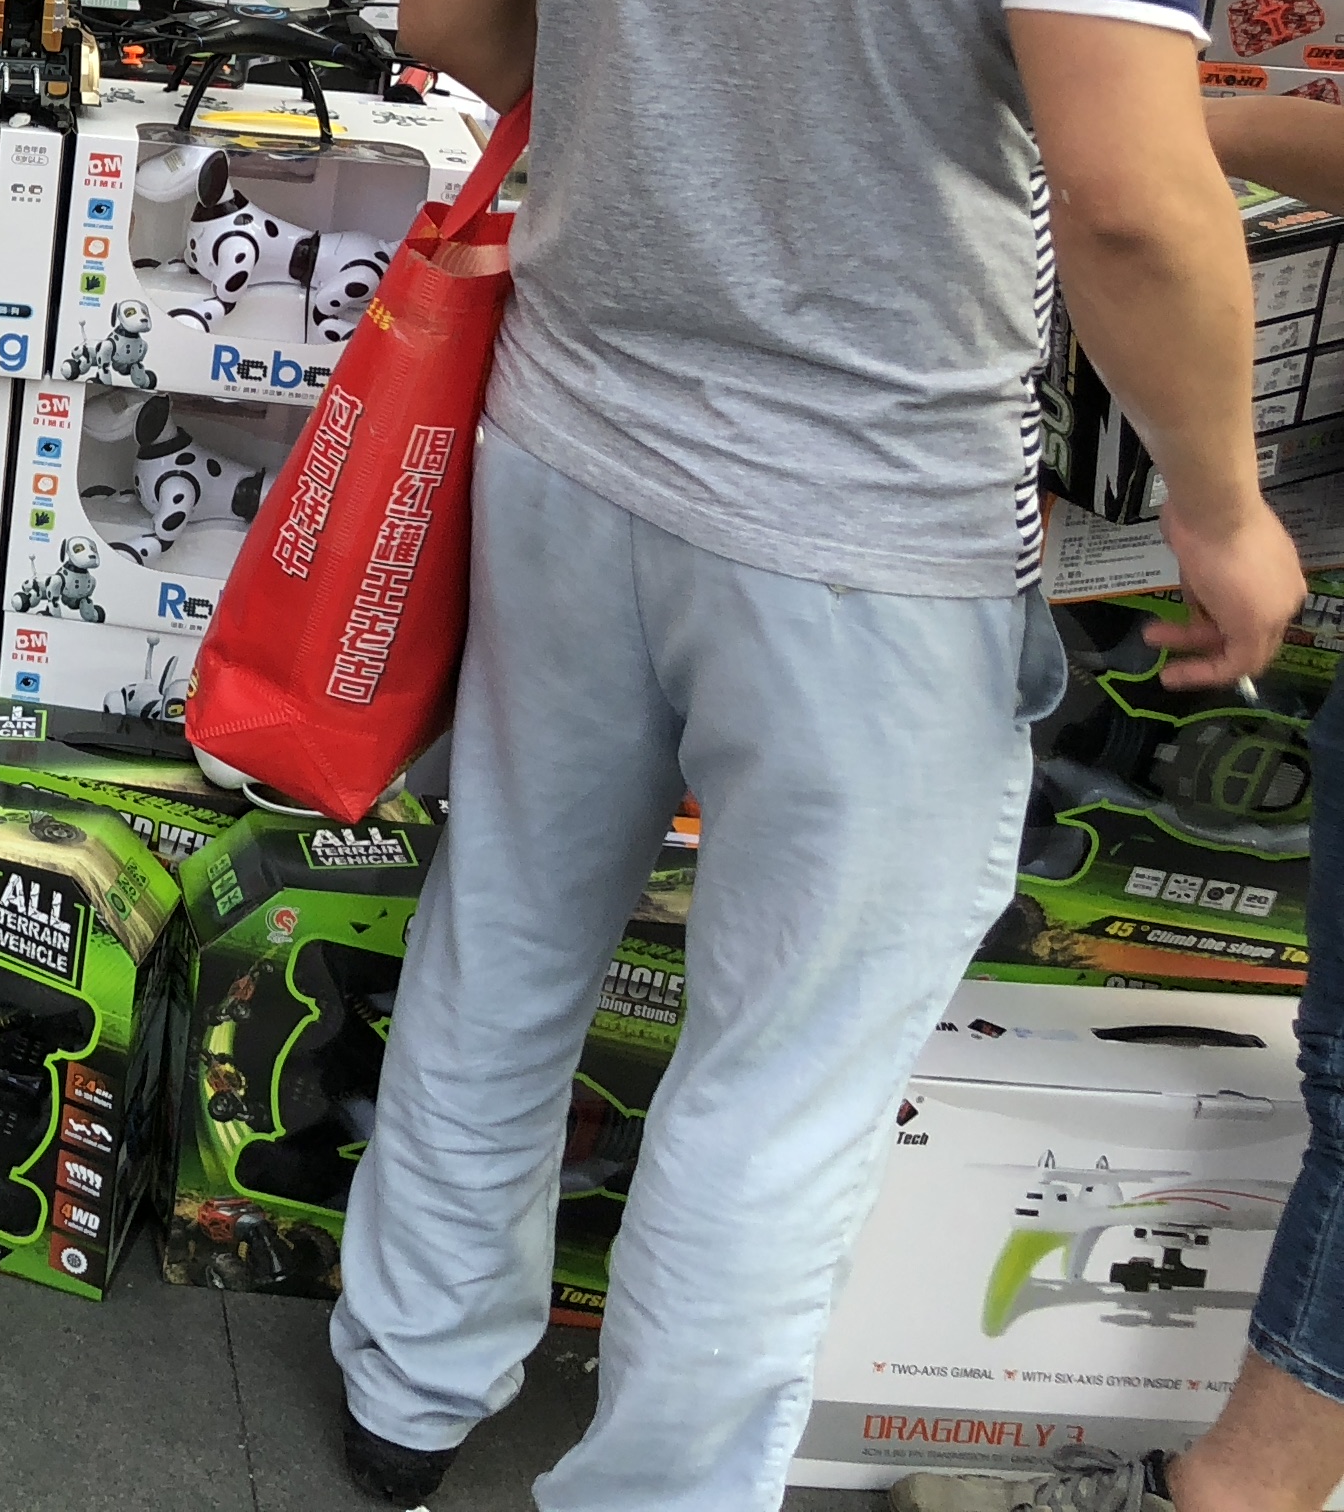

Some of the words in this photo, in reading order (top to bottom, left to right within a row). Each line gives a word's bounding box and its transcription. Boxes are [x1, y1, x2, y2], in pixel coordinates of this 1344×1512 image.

[84, 177, 124, 190] DIMEI
[32, 417, 72, 430] DIMEI
[325, 424, 457, 705] 喝红罐王老吉
[11, 653, 50, 665] DIMEI
[311, 826, 399, 848] ALL
[312, 844, 403, 855] TERRAIN
[318, 853, 408, 866] VEHICLE
[0, 874, 71, 934] ALL
[1146, 929, 1197, 948] Climb
[1196, 937, 1220, 953] the
[1220, 942, 1276, 959] slope
[633, 1005, 677, 1025] stunts
[896, 1130, 929, 1147] Tech
[61, 1203, 100, 1230] 4WD
[890, 1363, 949, 1378] TWO-AXIS
[950, 1367, 995, 1381] GIMBAL
[1022, 1371, 1052, 1383] WITH
[1054, 1373, 1105, 1386] SIX-AXIS
[1106, 1375, 1141, 1388] GYRO
[1143, 1378, 1182, 1391] INSIDE
[862, 1413, 1057, 1448] DRAGONFLY
